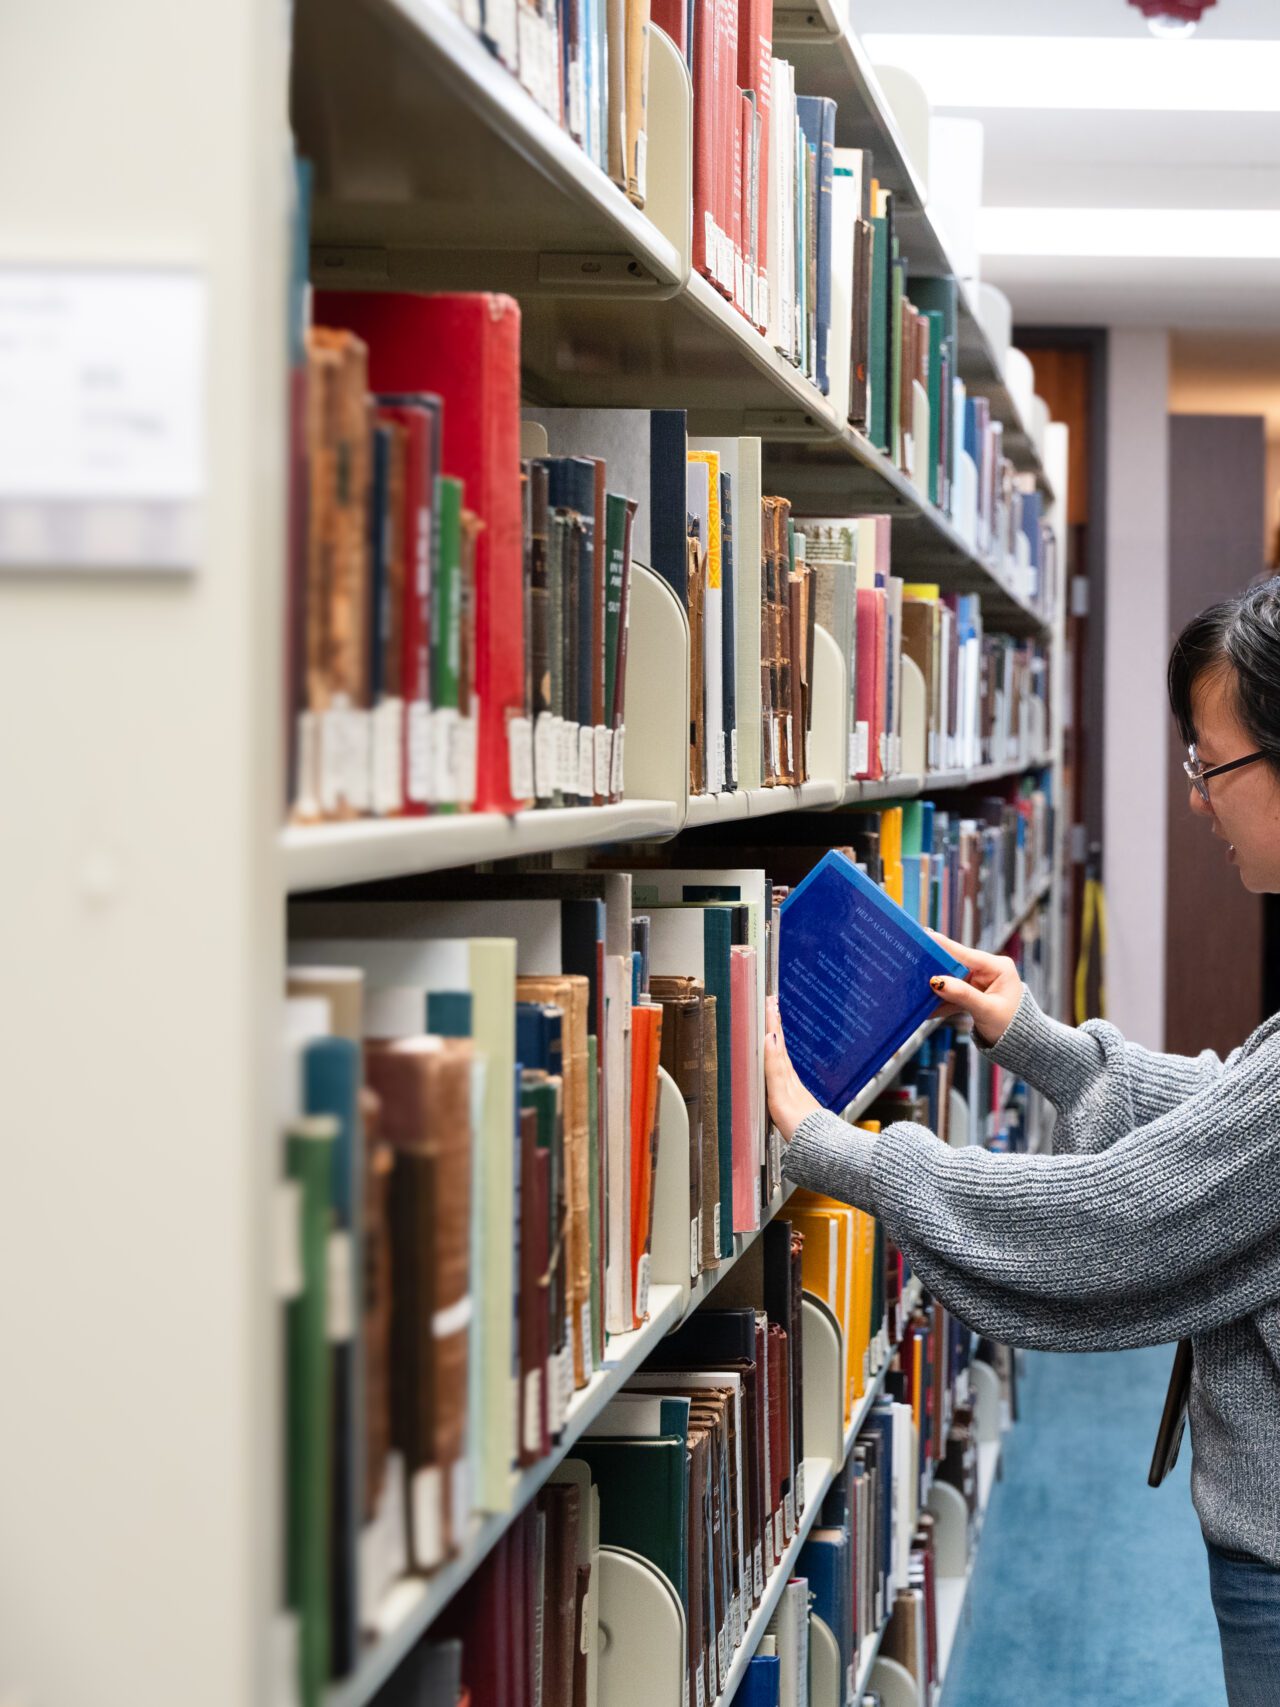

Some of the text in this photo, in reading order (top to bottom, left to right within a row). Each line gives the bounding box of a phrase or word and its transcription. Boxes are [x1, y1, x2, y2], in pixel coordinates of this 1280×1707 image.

[855, 906, 920, 965] HELP ALONG THE WAY
[854, 945, 864, 954] and
[816, 950, 826, 959] Ask
[824, 957, 842, 974] yourself
[839, 970, 848, 979] for
[835, 976, 843, 984] be
